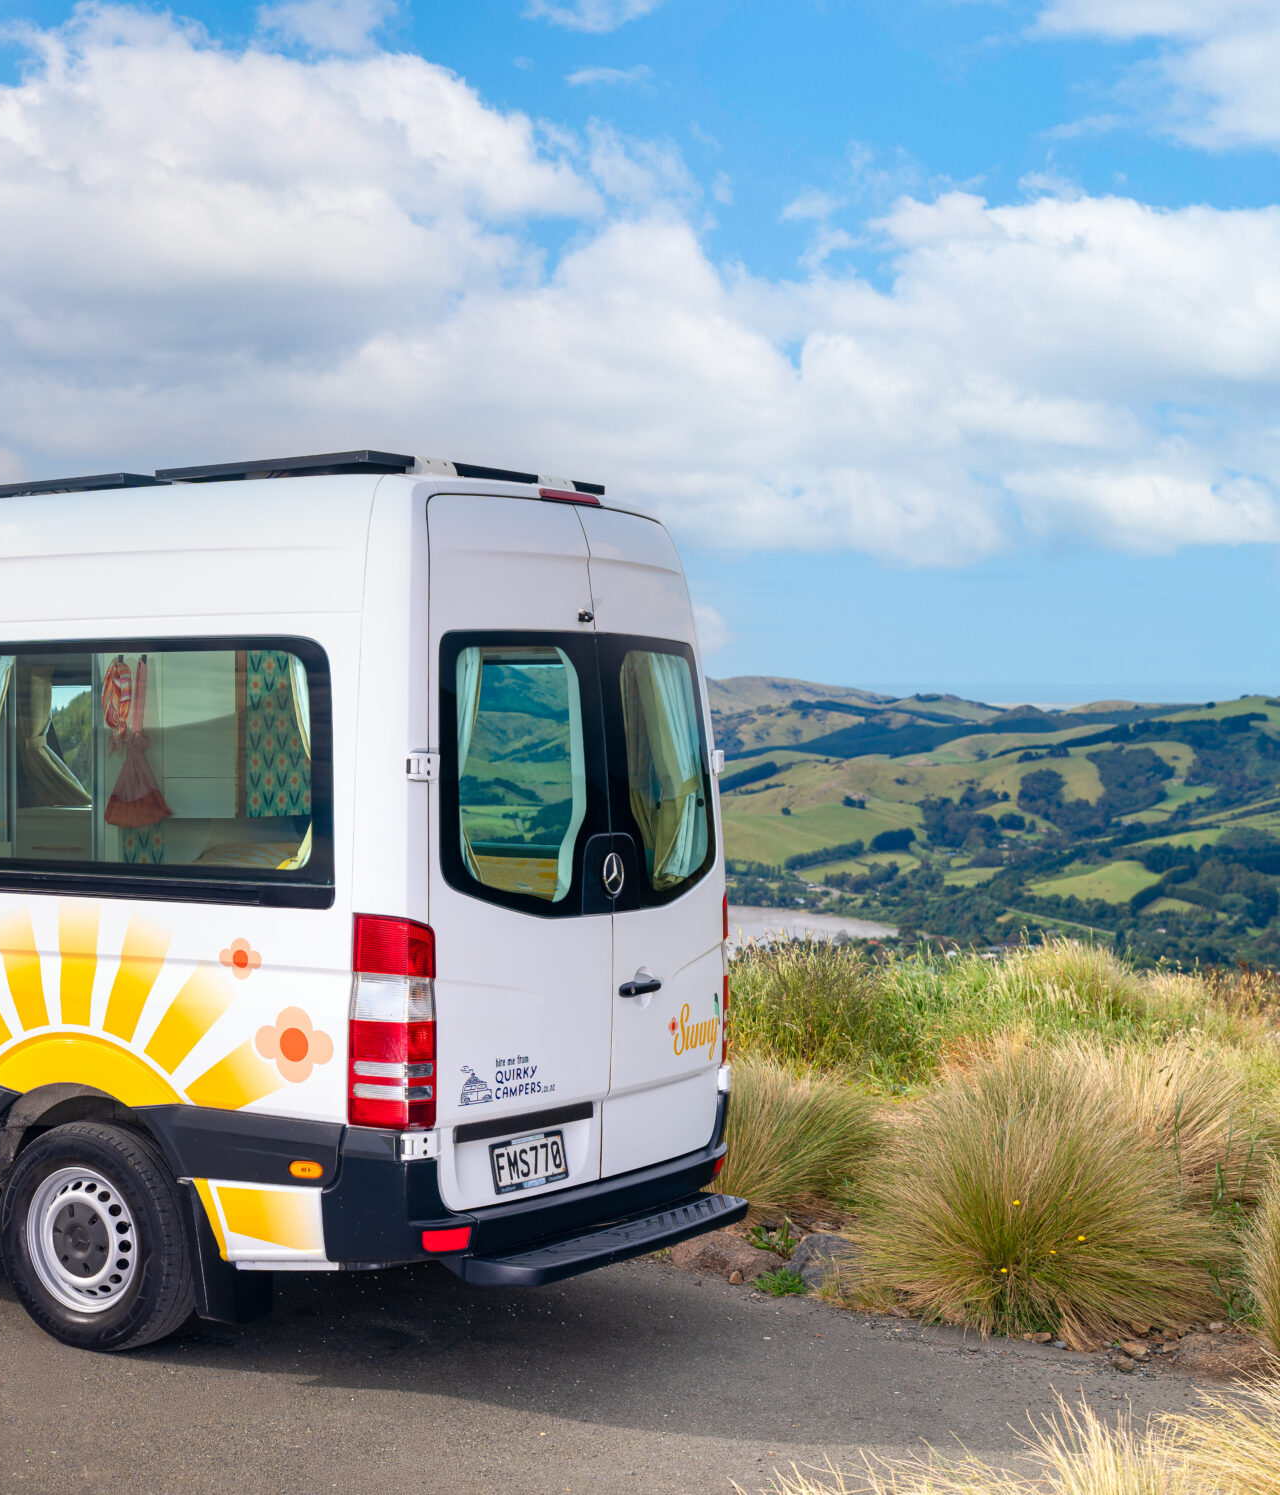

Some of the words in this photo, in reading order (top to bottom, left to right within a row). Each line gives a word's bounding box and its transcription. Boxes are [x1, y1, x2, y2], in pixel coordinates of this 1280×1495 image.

[674, 1003, 718, 1060] Sunny
[495, 1065, 537, 1084] QUIRKY
[496, 1141, 562, 1182] FMS770
